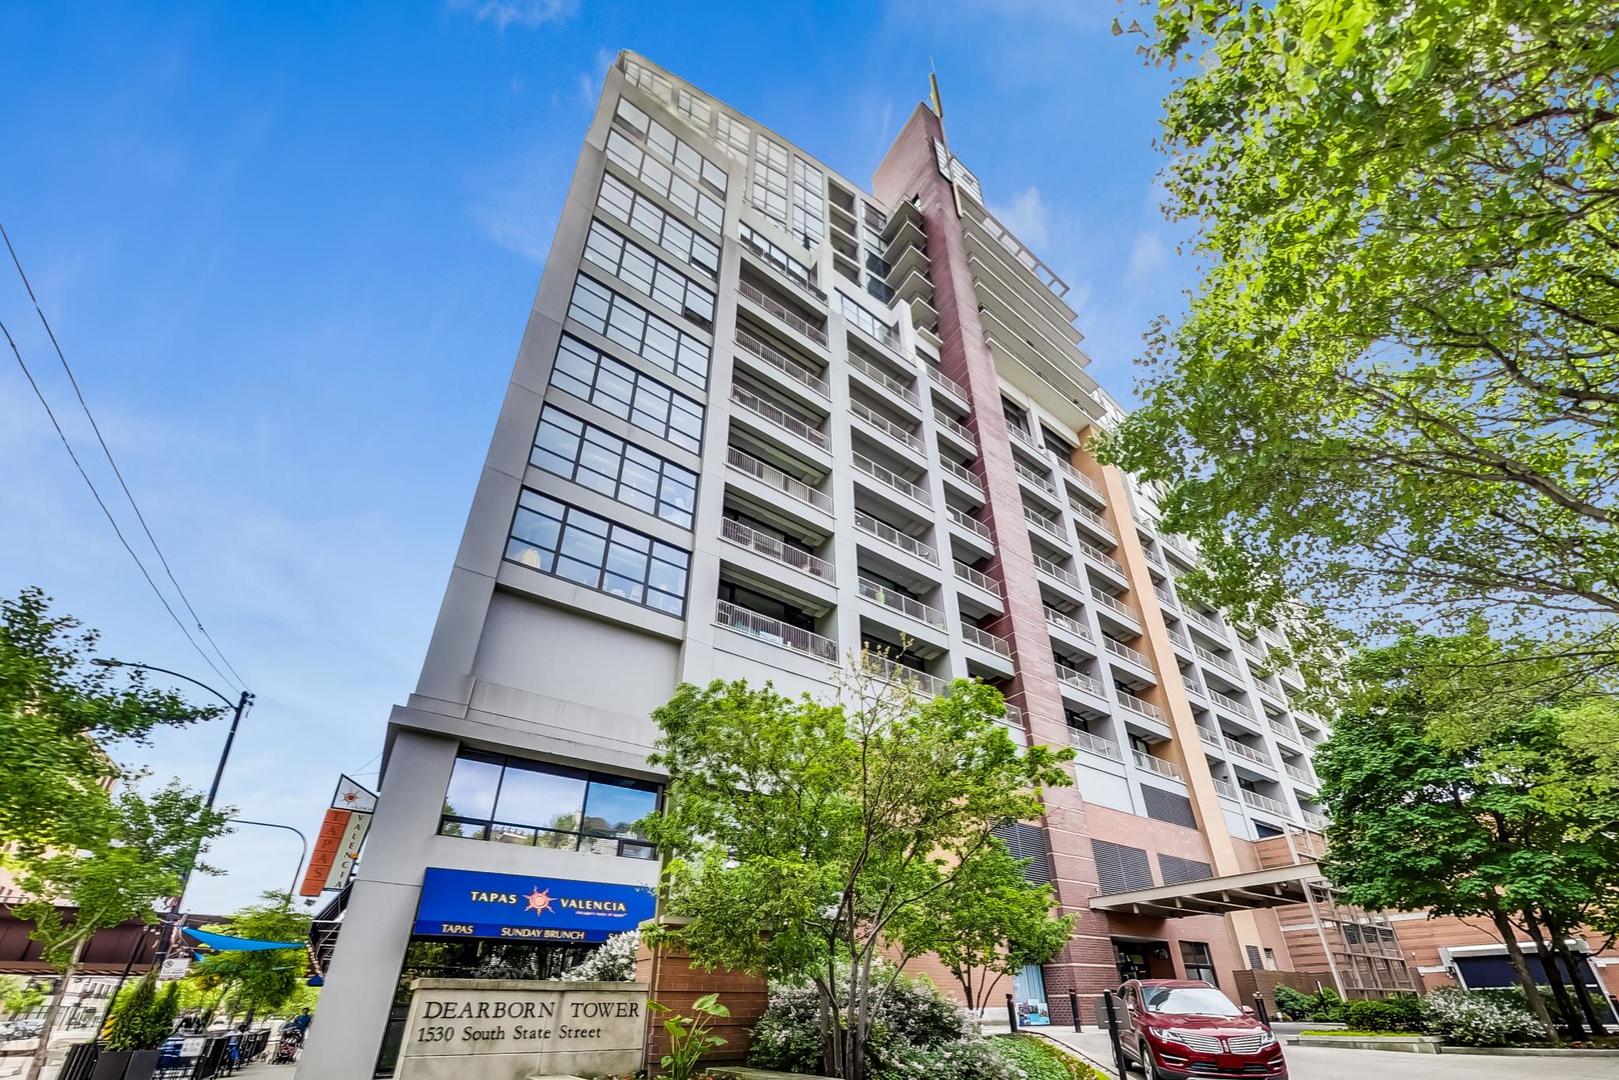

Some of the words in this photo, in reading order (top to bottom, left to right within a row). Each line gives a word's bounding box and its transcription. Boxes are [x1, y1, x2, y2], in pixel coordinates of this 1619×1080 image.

[313, 811, 340, 879] TAPAS
[334, 814, 365, 888] VALENCIA
[470, 891, 517, 904] TAPAS
[560, 898, 627, 912] VALENCIA
[441, 924, 475, 935] TAPAS
[501, 927, 543, 938] SUNDAY
[543, 929, 585, 940] BRUNCH
[422, 1001, 555, 1019] DEARBORN
[570, 1002, 640, 1018] TOWER
[417, 1026, 455, 1042] 1530
[462, 1025, 505, 1041] South
[513, 1025, 552, 1040] State
[559, 1024, 602, 1039] Street
